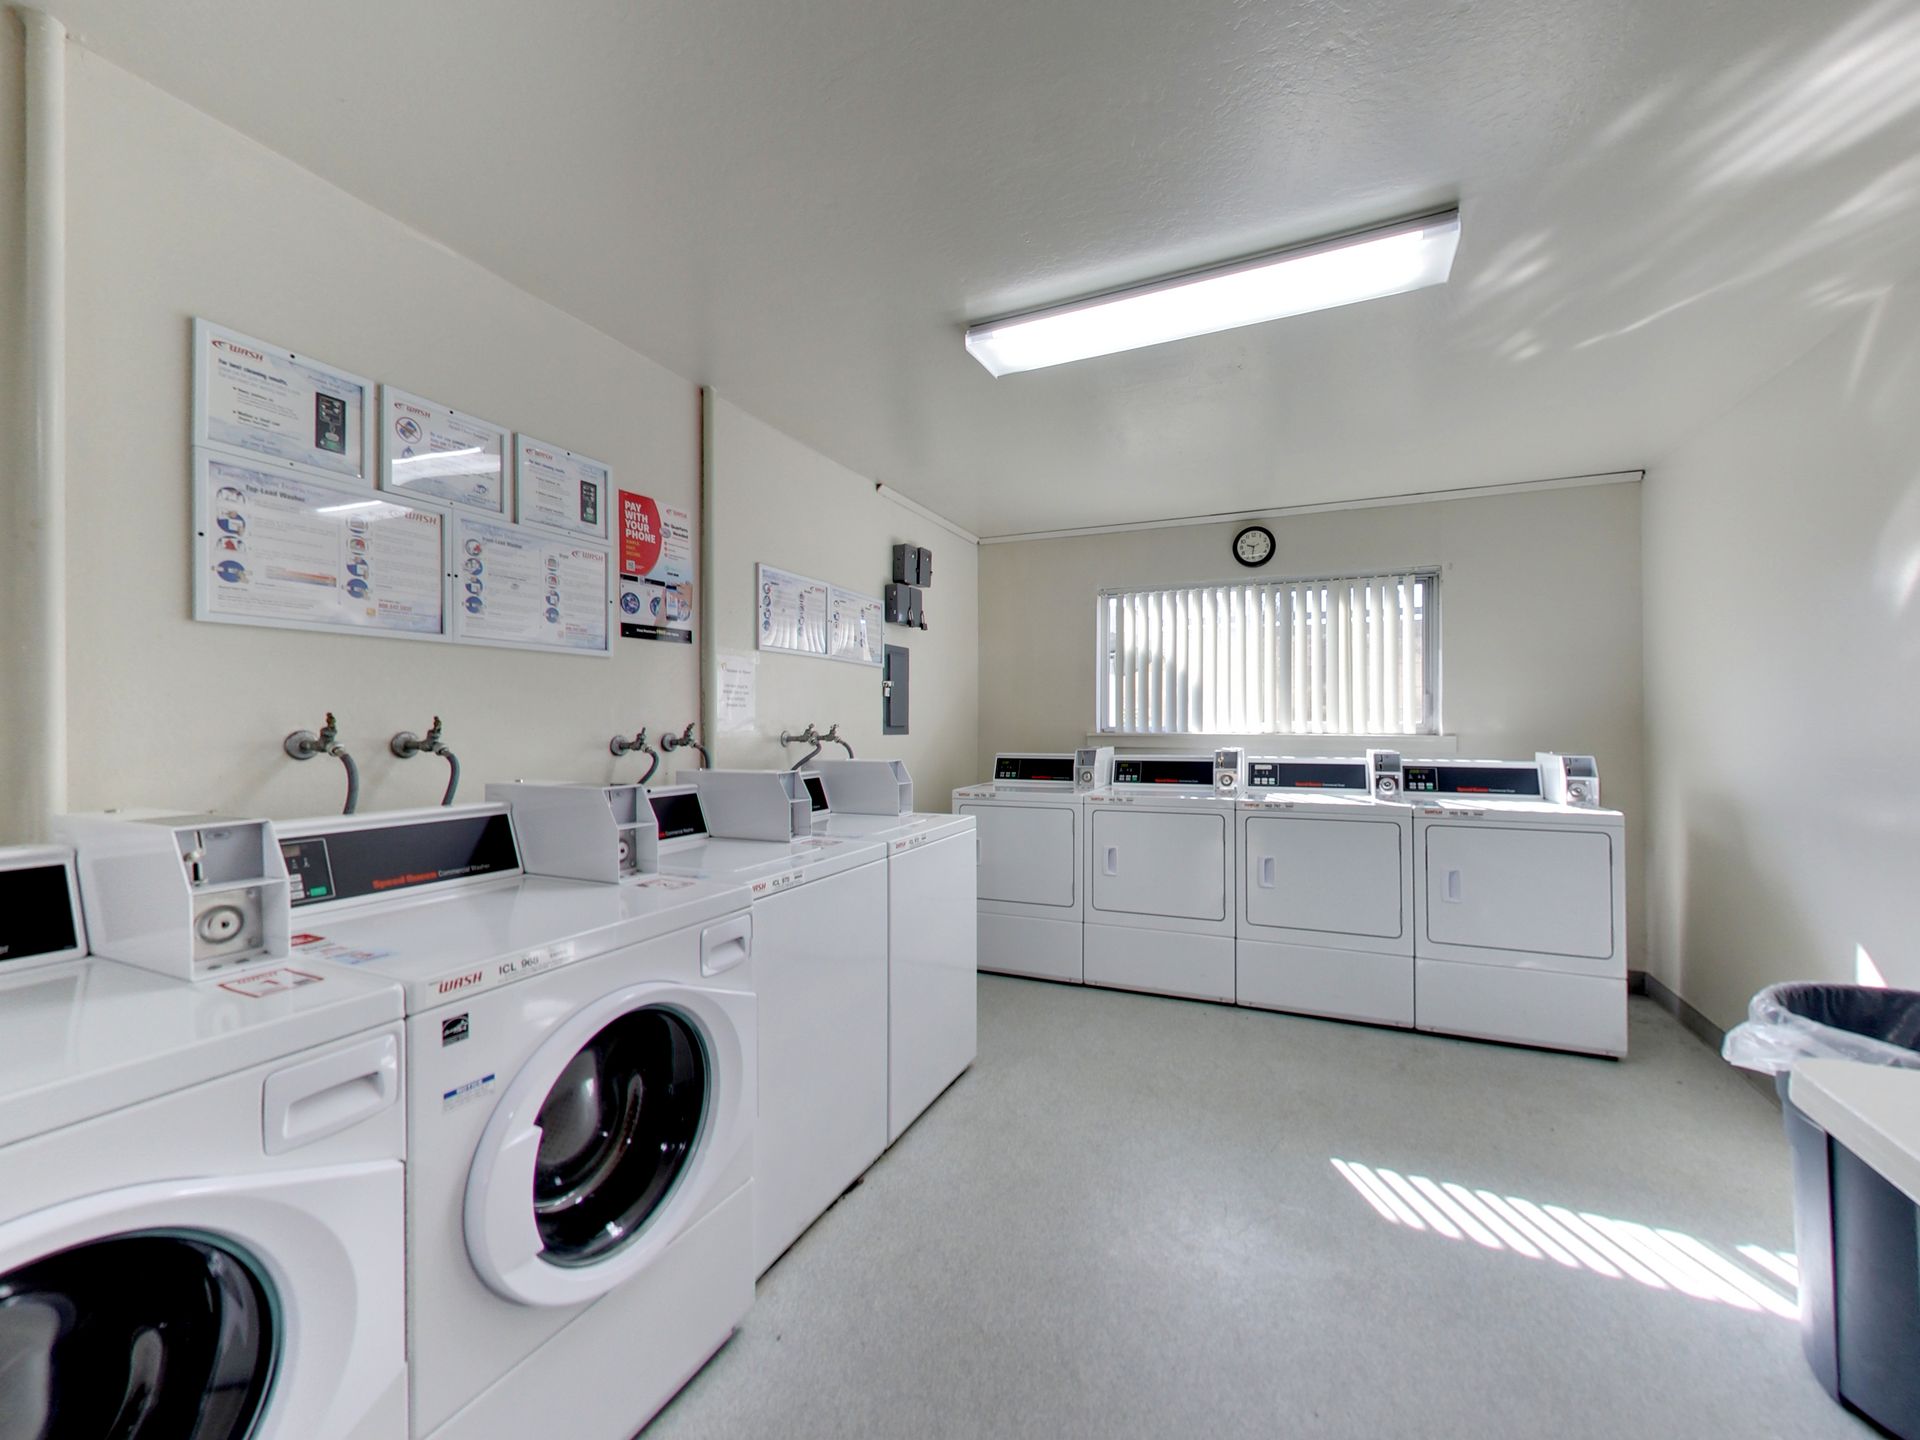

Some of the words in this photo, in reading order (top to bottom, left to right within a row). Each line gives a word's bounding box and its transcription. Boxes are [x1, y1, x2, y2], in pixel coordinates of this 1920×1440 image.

[229, 343, 264, 361] WASH
[406, 405, 431, 418] WASH
[624, 500, 642, 512] PAY
[624, 510, 649, 524] WITH
[625, 518, 650, 533] YOUR
[625, 528, 656, 544] PHONE
[582, 551, 604, 562] WASH
[438, 971, 483, 994] WASH
[499, 962, 517, 975] ICL
